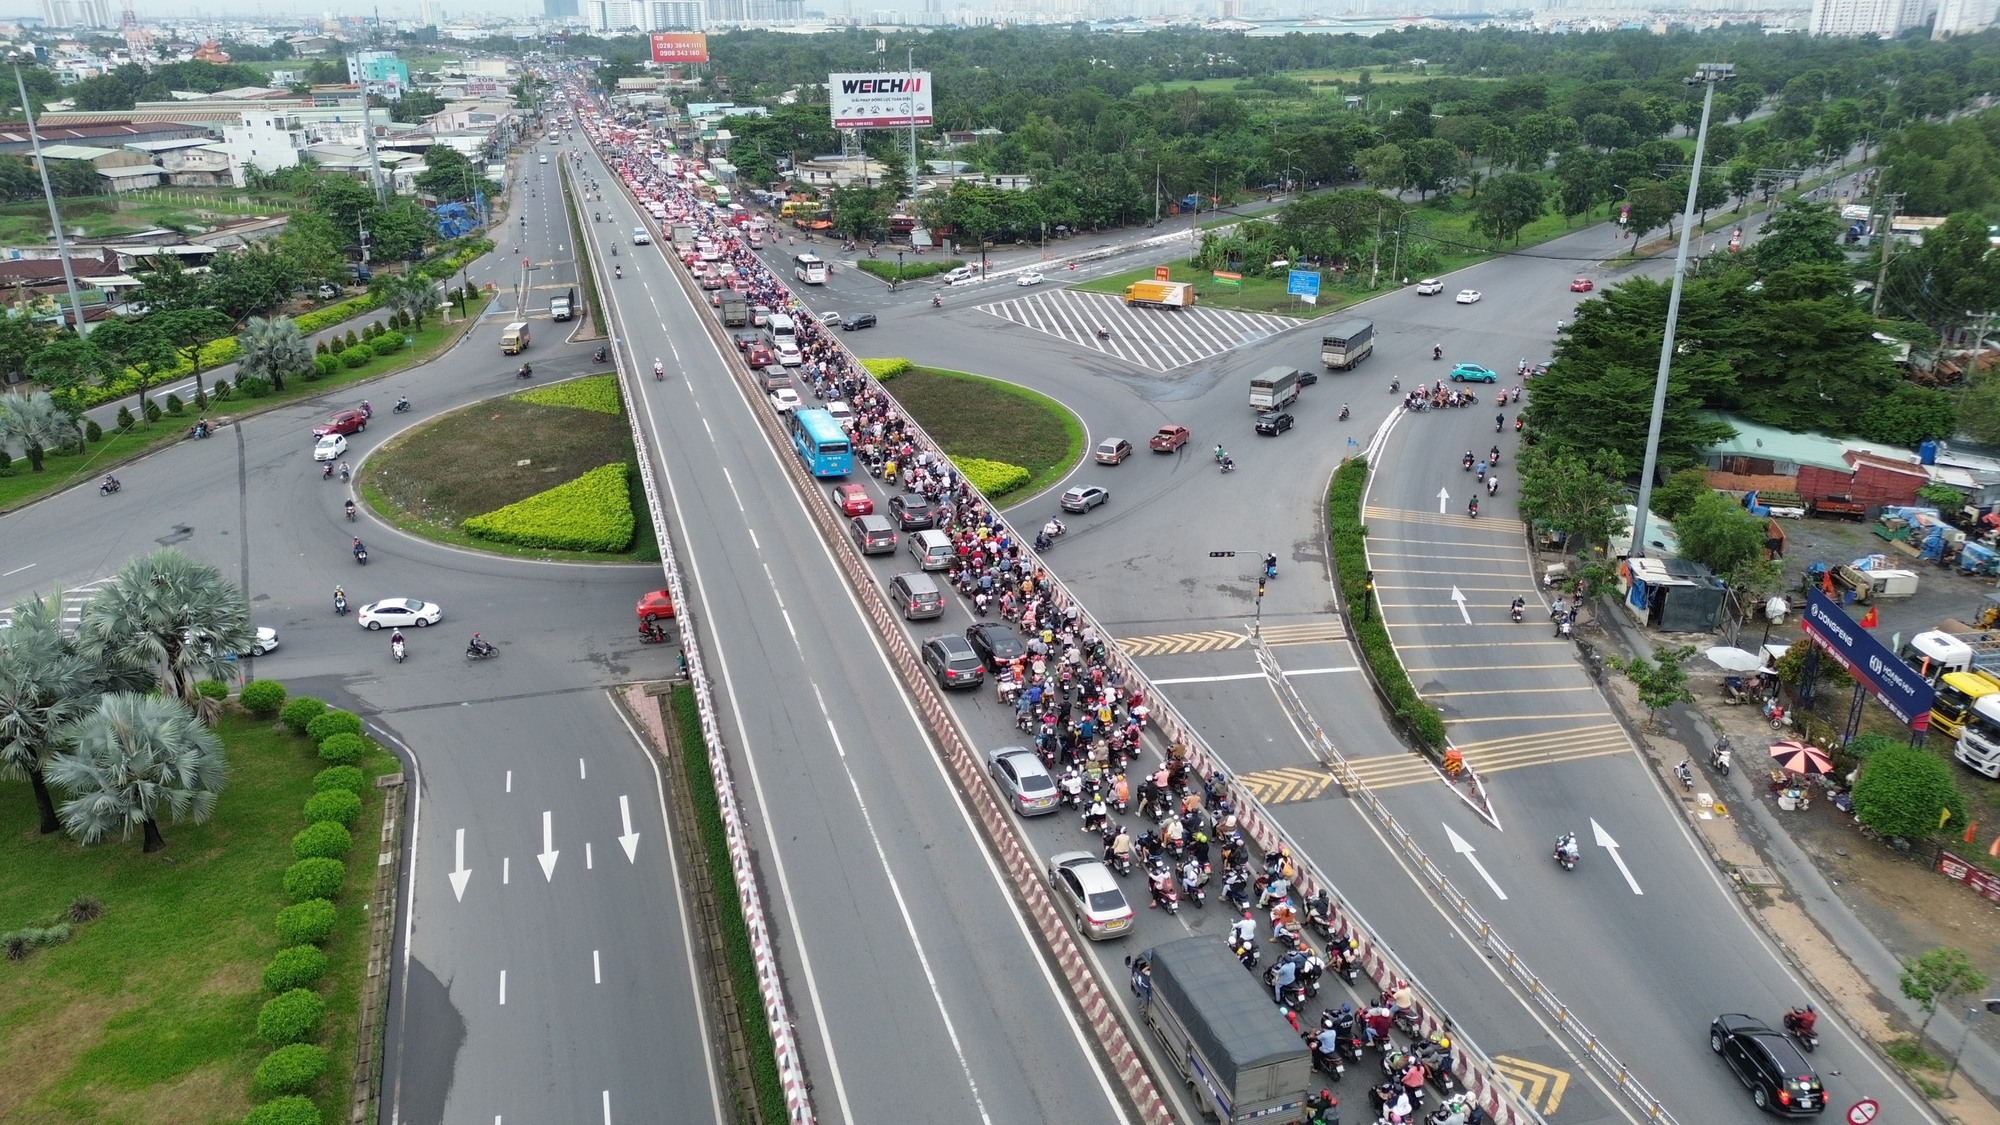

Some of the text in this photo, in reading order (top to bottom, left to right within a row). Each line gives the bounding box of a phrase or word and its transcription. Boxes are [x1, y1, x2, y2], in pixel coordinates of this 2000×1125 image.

[842, 78, 922, 94] WEICHAI
[1817, 610, 1853, 647] DONGFENG
[1901, 681, 1916, 697] HUY
